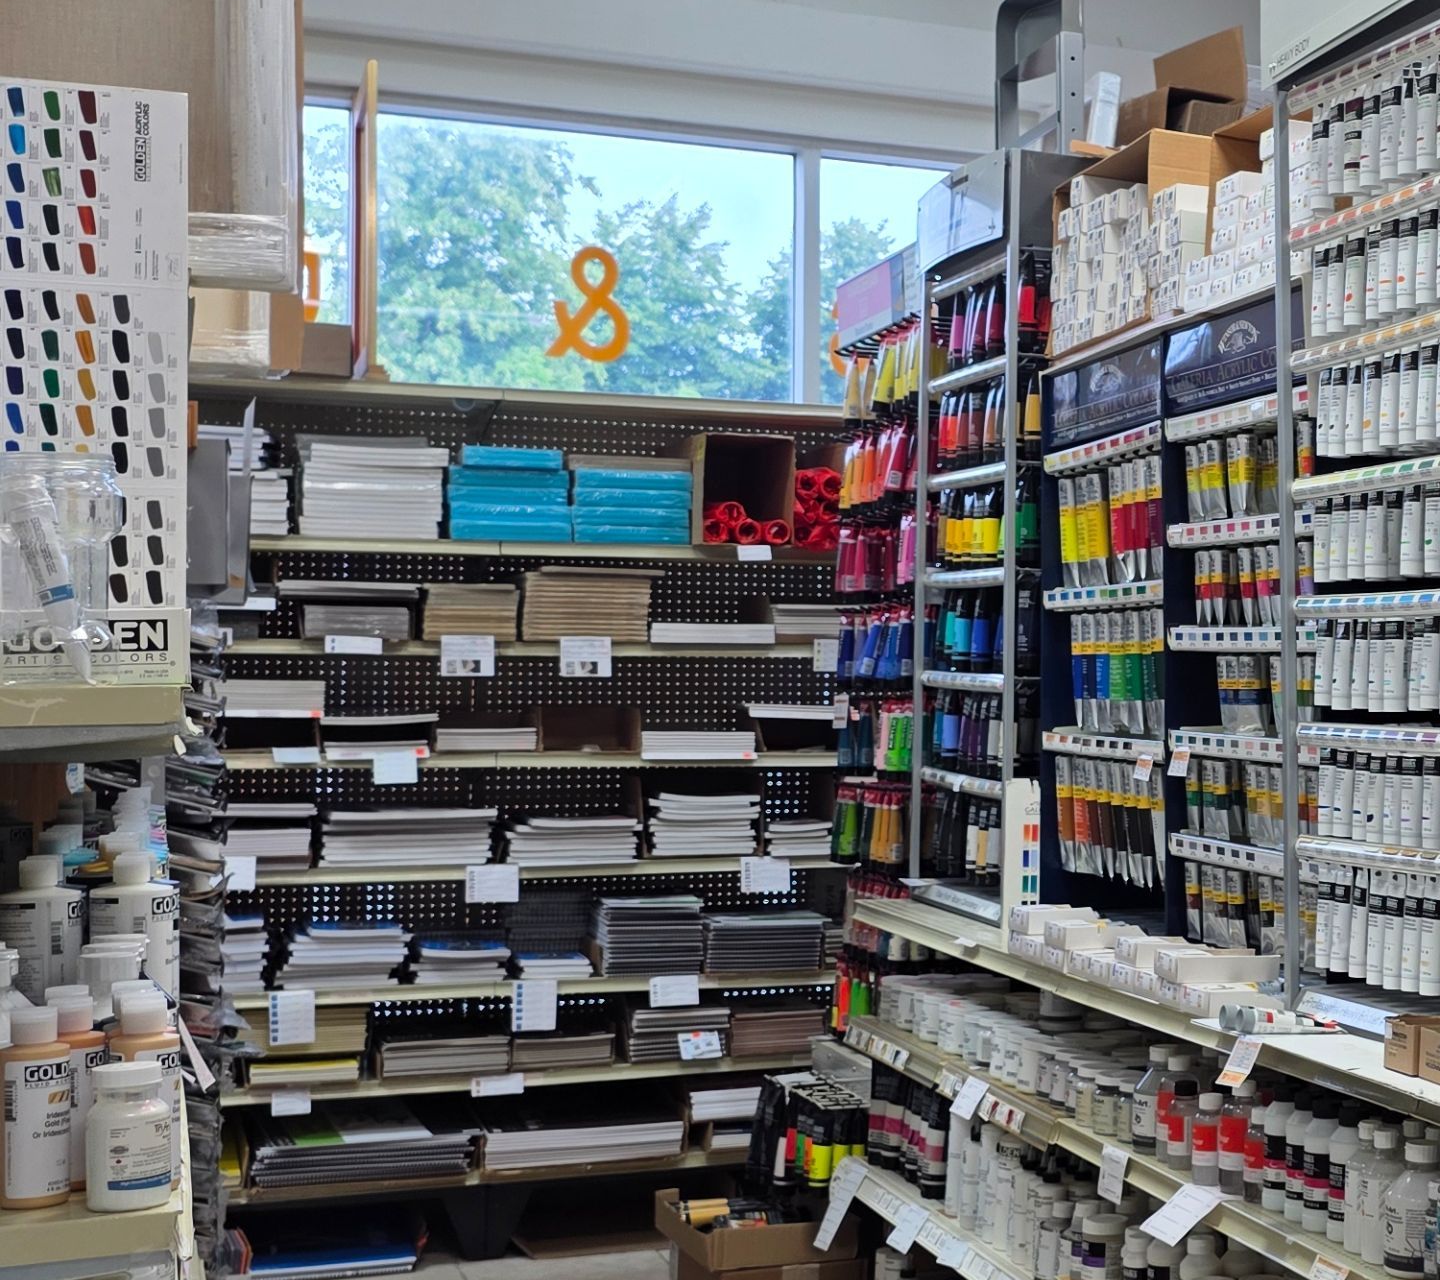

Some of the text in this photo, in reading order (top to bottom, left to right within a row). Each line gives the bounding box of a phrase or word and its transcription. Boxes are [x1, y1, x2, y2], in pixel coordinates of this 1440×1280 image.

[1276, 36, 1311, 71] HEAVY BODY
[142, 103, 150, 136] COLORS
[134, 101, 147, 182] GOLDEN ACRYLIC
[4, 619, 168, 655] GODEN
[4, 653, 63, 665] ARTIS
[25, 1066, 70, 1082] GOLD
